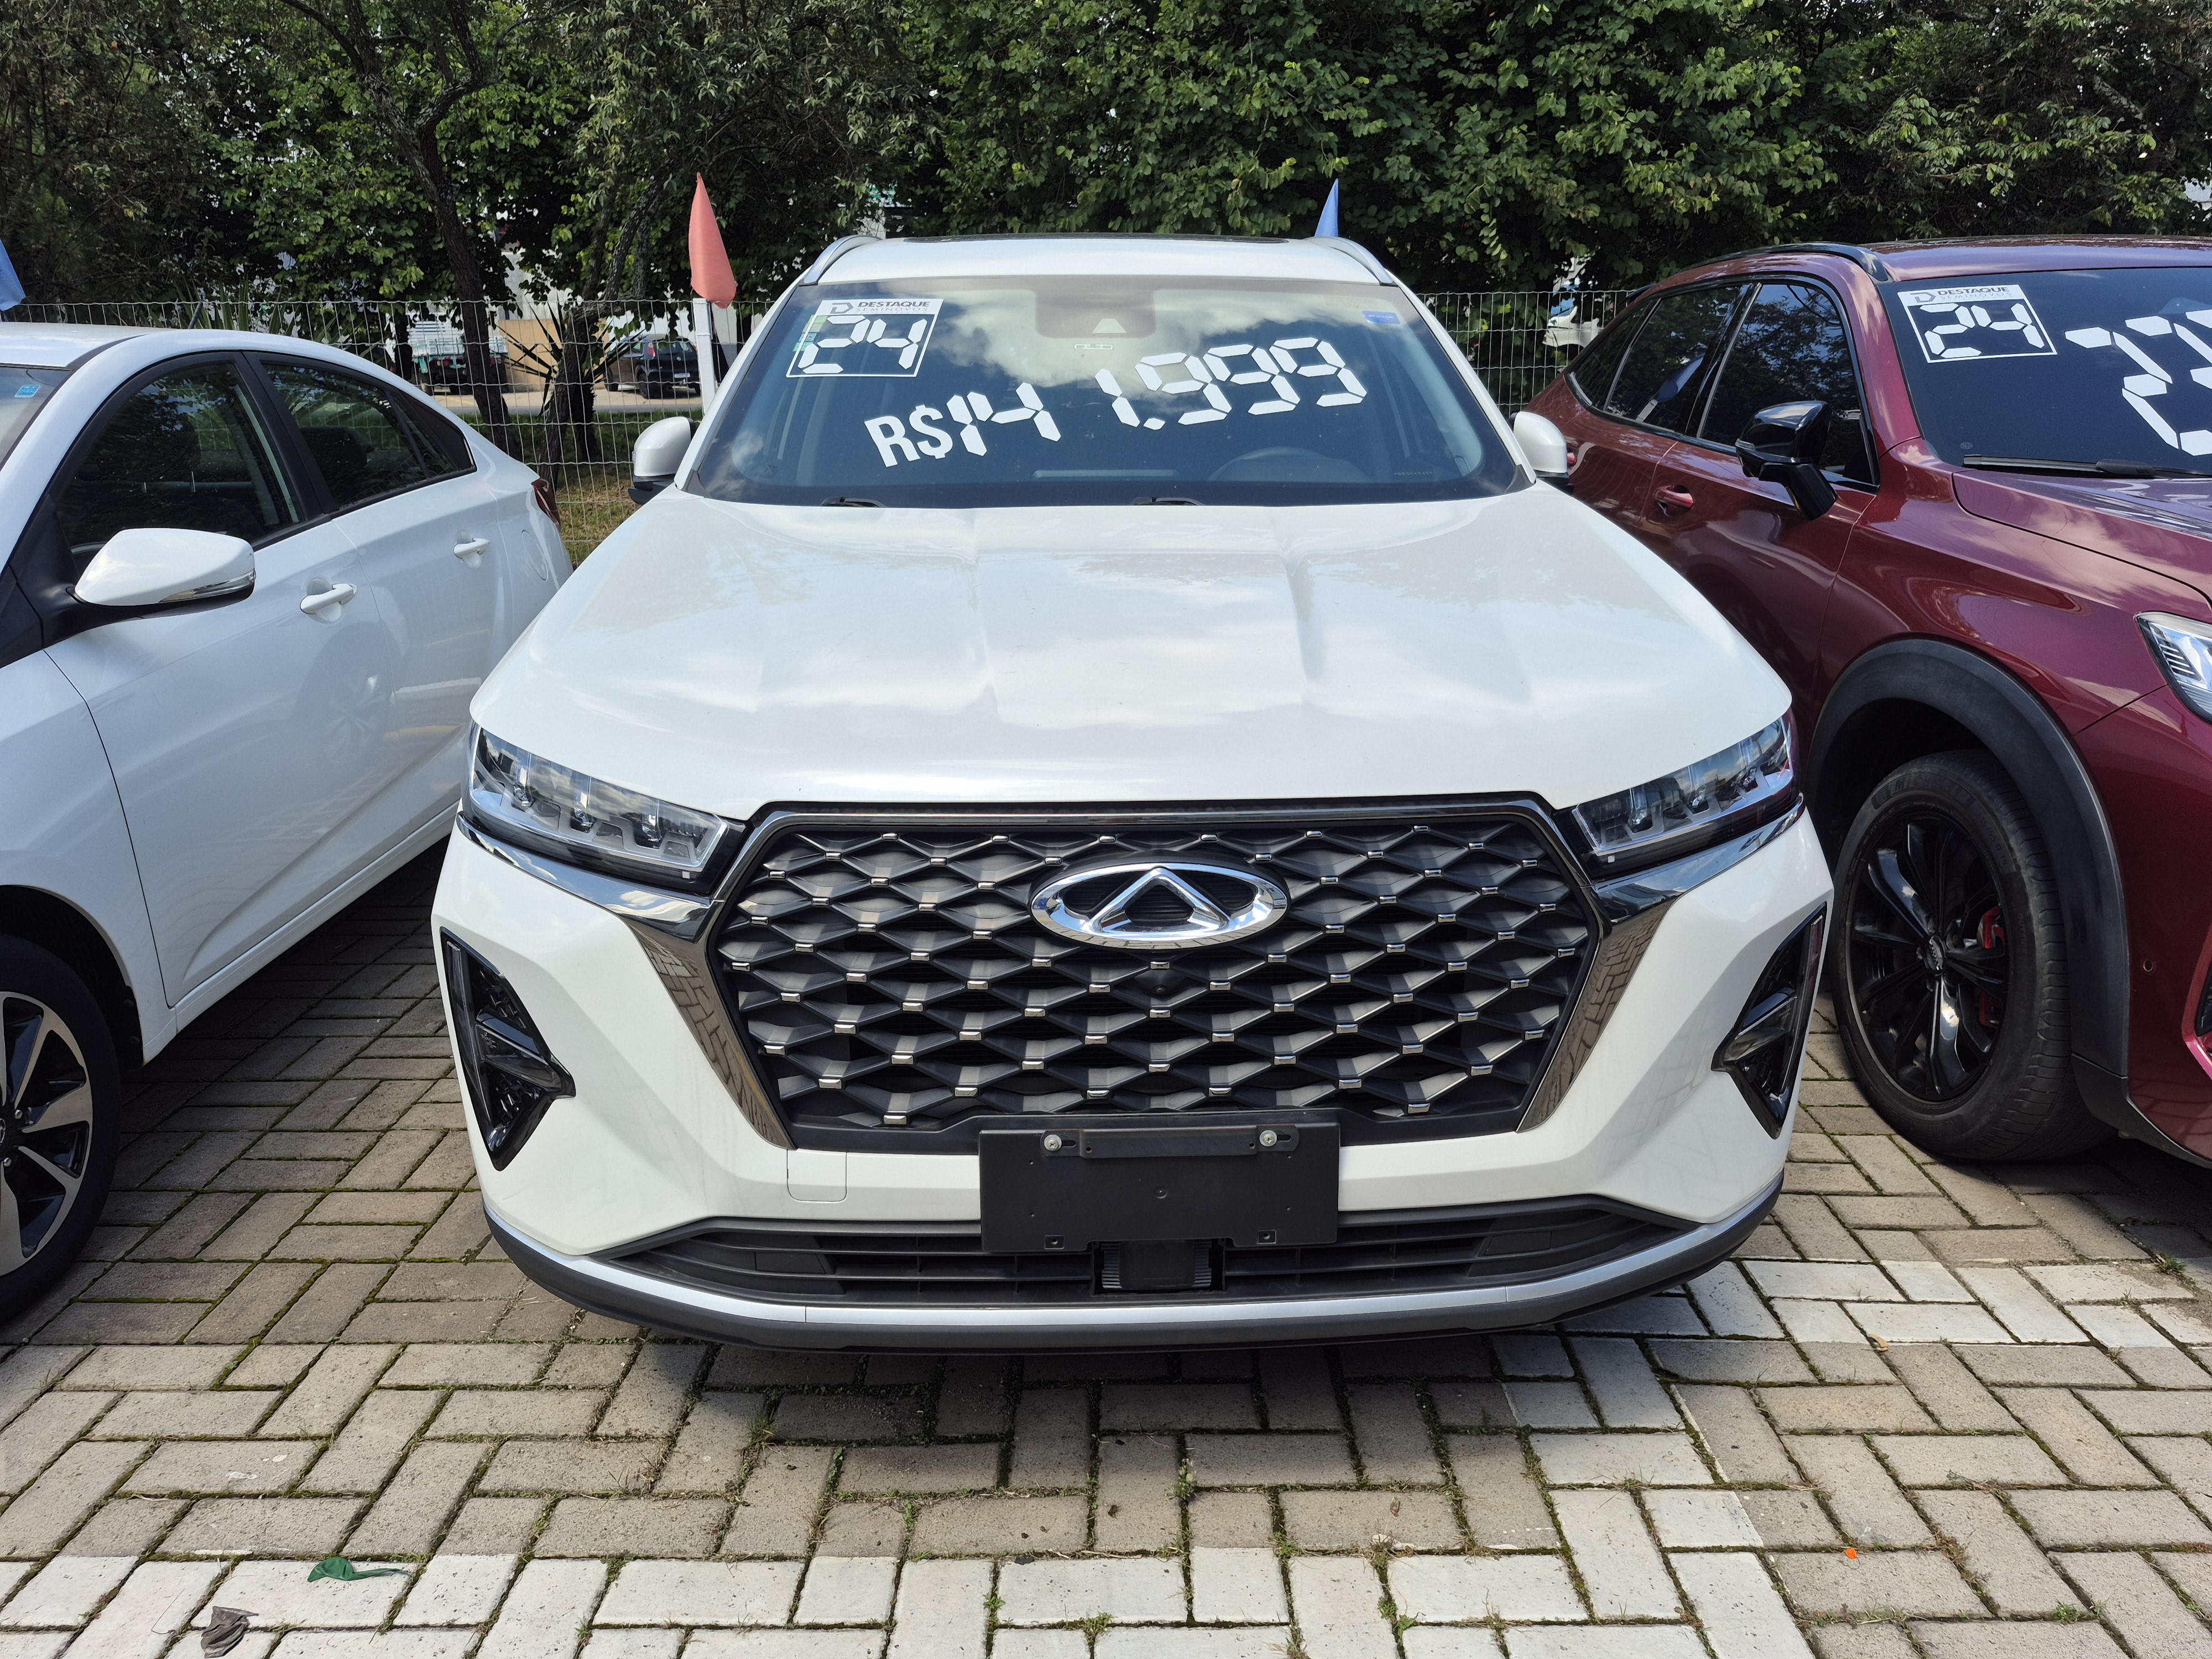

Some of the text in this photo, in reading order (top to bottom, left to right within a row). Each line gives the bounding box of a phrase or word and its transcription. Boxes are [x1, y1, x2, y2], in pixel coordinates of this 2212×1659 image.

[1937, 287, 2010, 295] DESTAQUE
[797, 315, 928, 374] 24
[1919, 302, 2045, 358] 24
